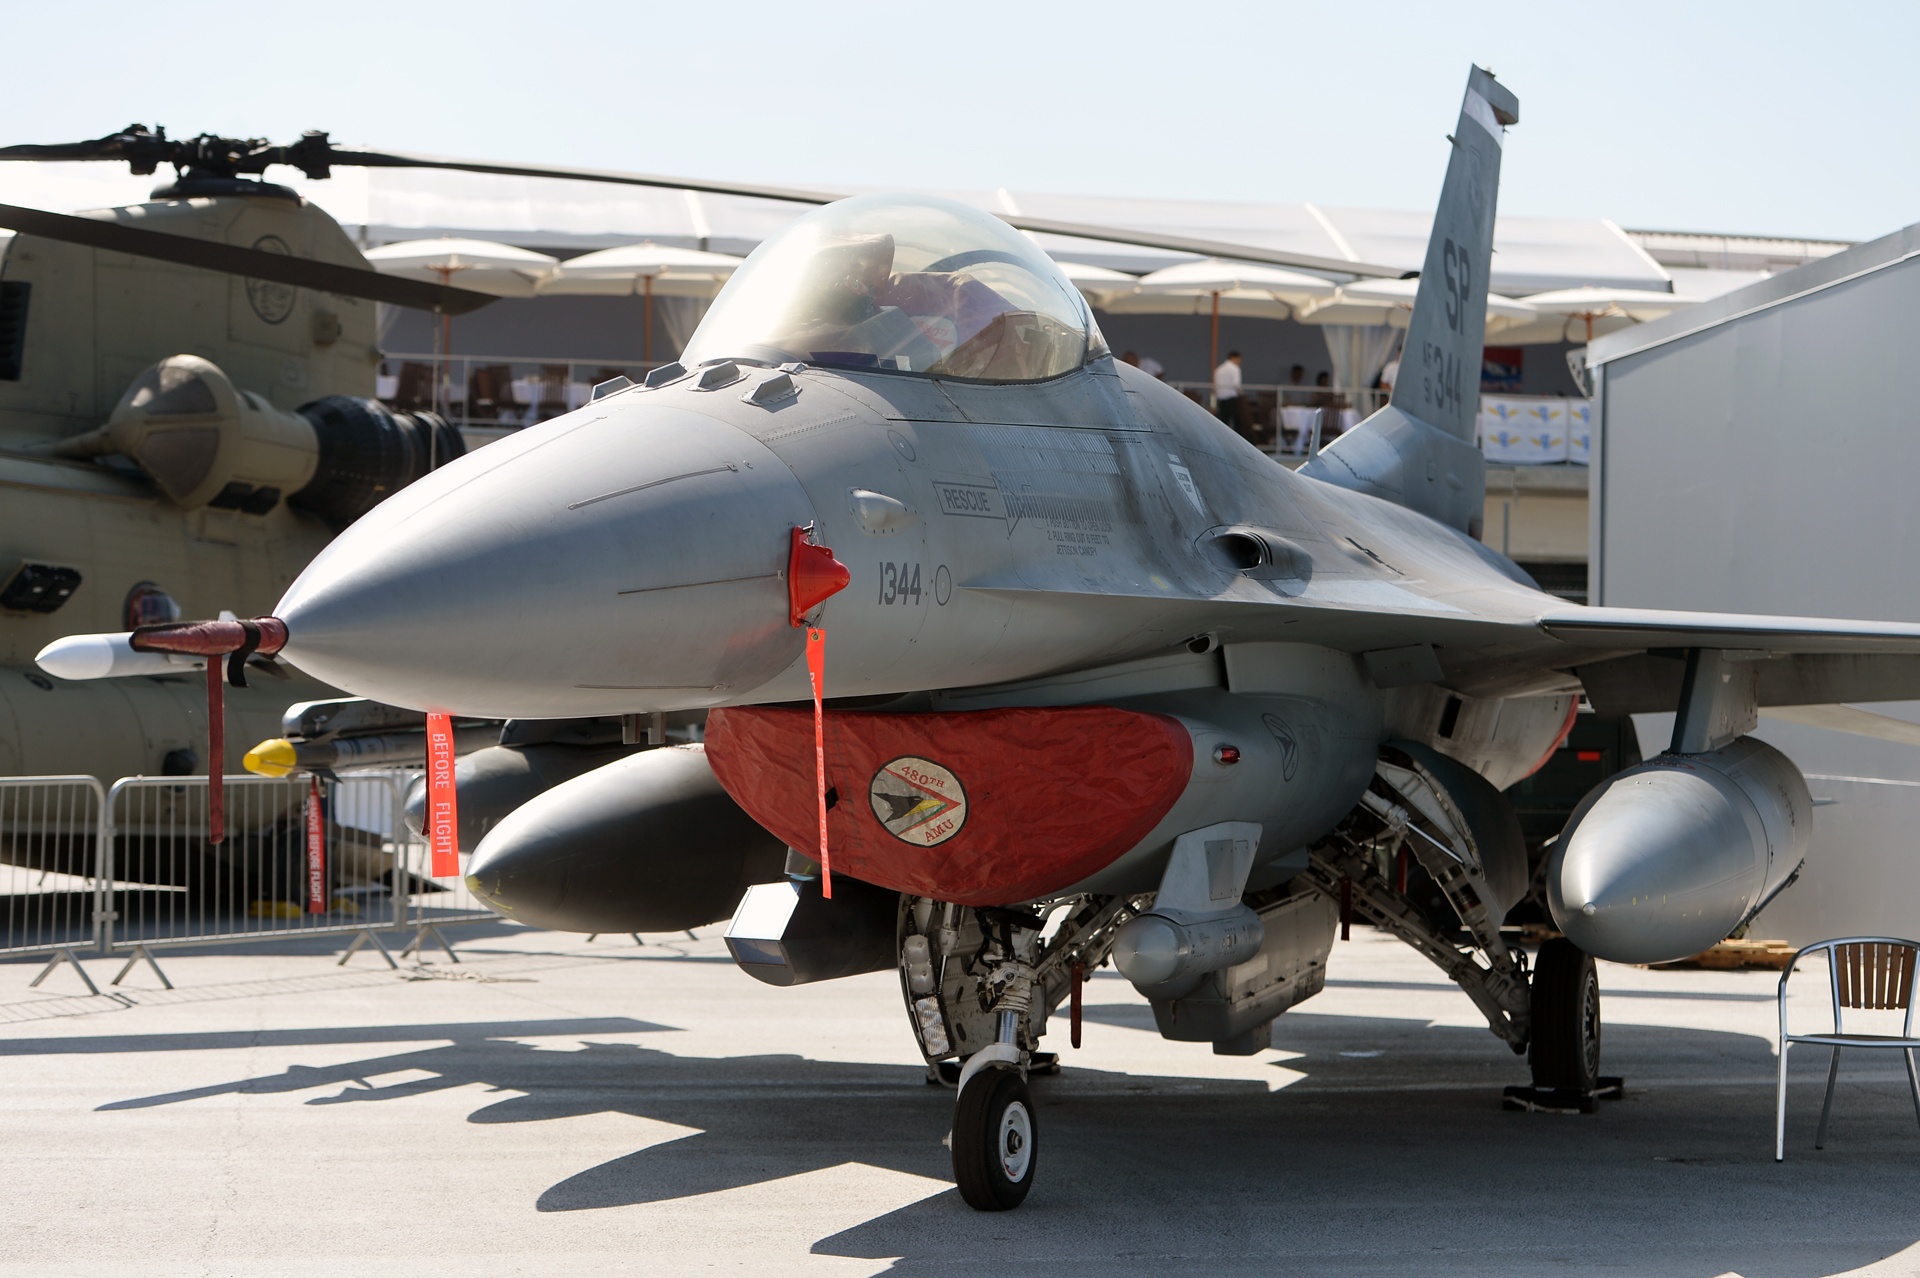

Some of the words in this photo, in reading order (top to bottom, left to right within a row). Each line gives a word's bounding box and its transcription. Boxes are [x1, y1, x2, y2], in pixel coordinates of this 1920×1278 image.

[1443, 237, 1471, 336] SP
[1434, 345, 1462, 420] 344
[942, 488, 991, 512] RESCUE
[1052, 530, 1064, 542] PULL
[1064, 531, 1076, 543] RING
[1076, 532, 1086, 544] OUT
[1090, 534, 1102, 545] FEET
[1102, 534, 1110, 545] TO
[1056, 544, 1079, 556] JETTISON
[1078, 545, 1098, 557] CANOPY
[878, 561, 922, 606] 1344
[432, 733, 450, 789] BEFORE
[901, 766, 945, 788] 480TH
[435, 802, 452, 855] FLIGHT
[923, 818, 955, 843] AMU
[309, 833, 321, 870] BEFORE
[310, 870, 322, 903] FLIGHT
